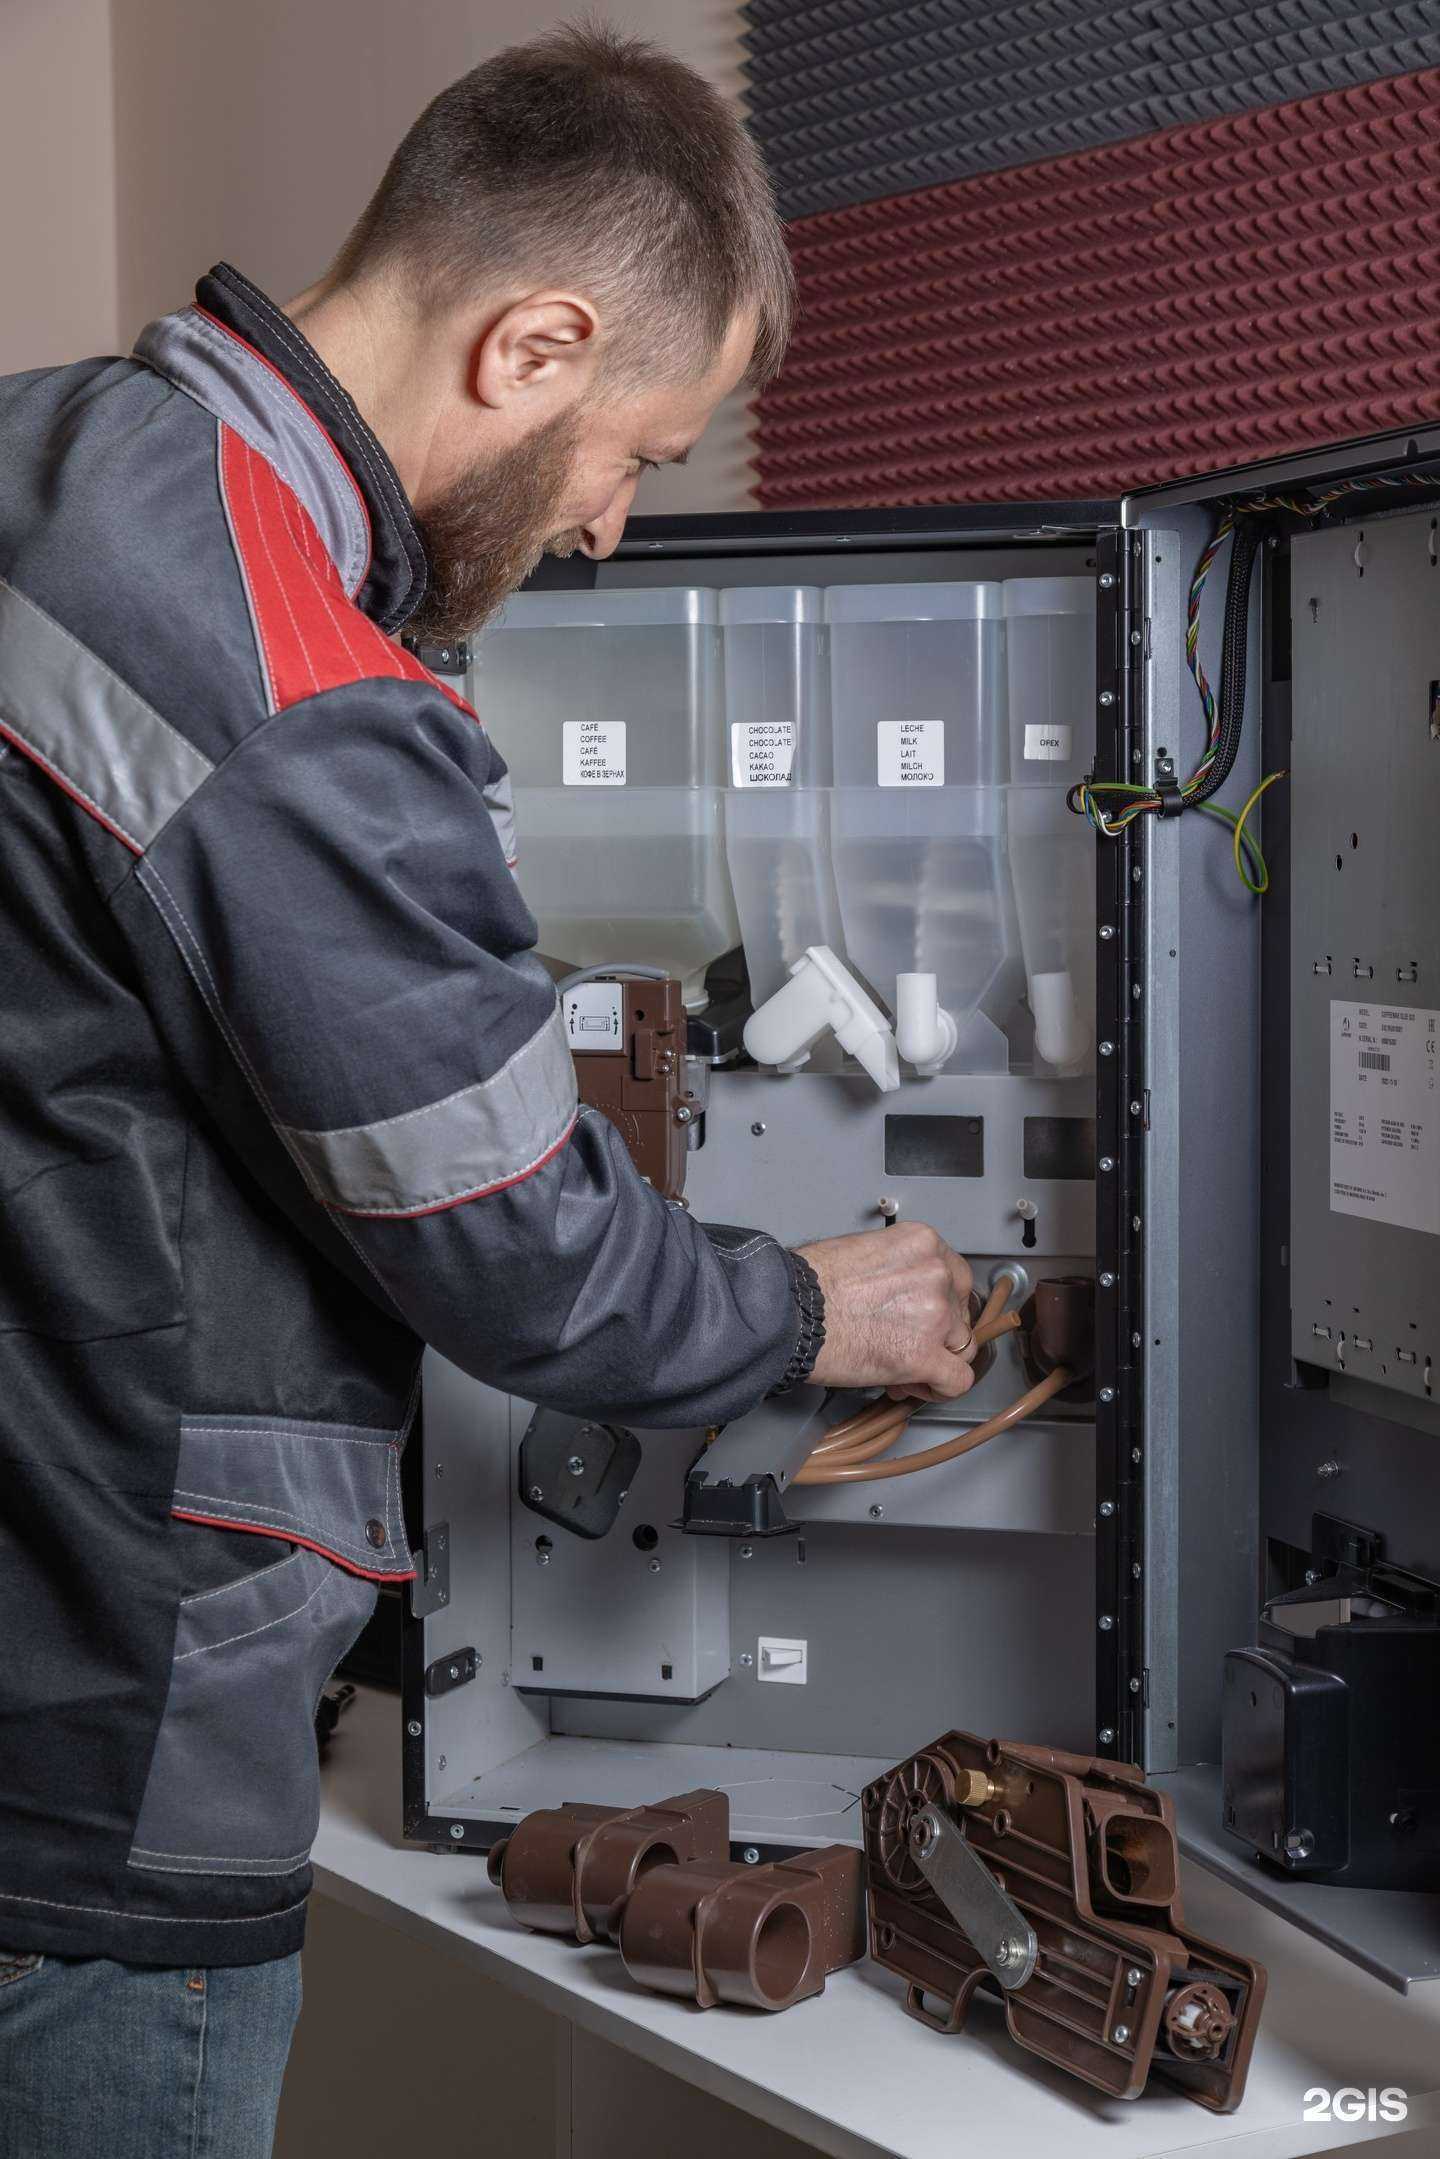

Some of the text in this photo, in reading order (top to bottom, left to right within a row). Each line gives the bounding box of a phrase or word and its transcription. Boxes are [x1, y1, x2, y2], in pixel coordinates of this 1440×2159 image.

[748, 725, 792, 735] CHOCOLATE
[900, 724, 926, 733] LECHE
[580, 735, 607, 743] COFFEE
[748, 738, 792, 747] CHOCOLATE
[900, 737, 918, 745] MILK
[1039, 738, 1060, 747] ОРЕХ
[749, 751, 774, 760] CACAO
[900, 750, 916, 758] LAIT
[579, 758, 606, 767] KAFFEE
[900, 762, 923, 770] MILCH
[602, 770, 625, 778] ЗЕРНАХ
[749, 772, 792, 782] ШОКОЛАД
[901, 773, 934, 781] МОЛОКО
